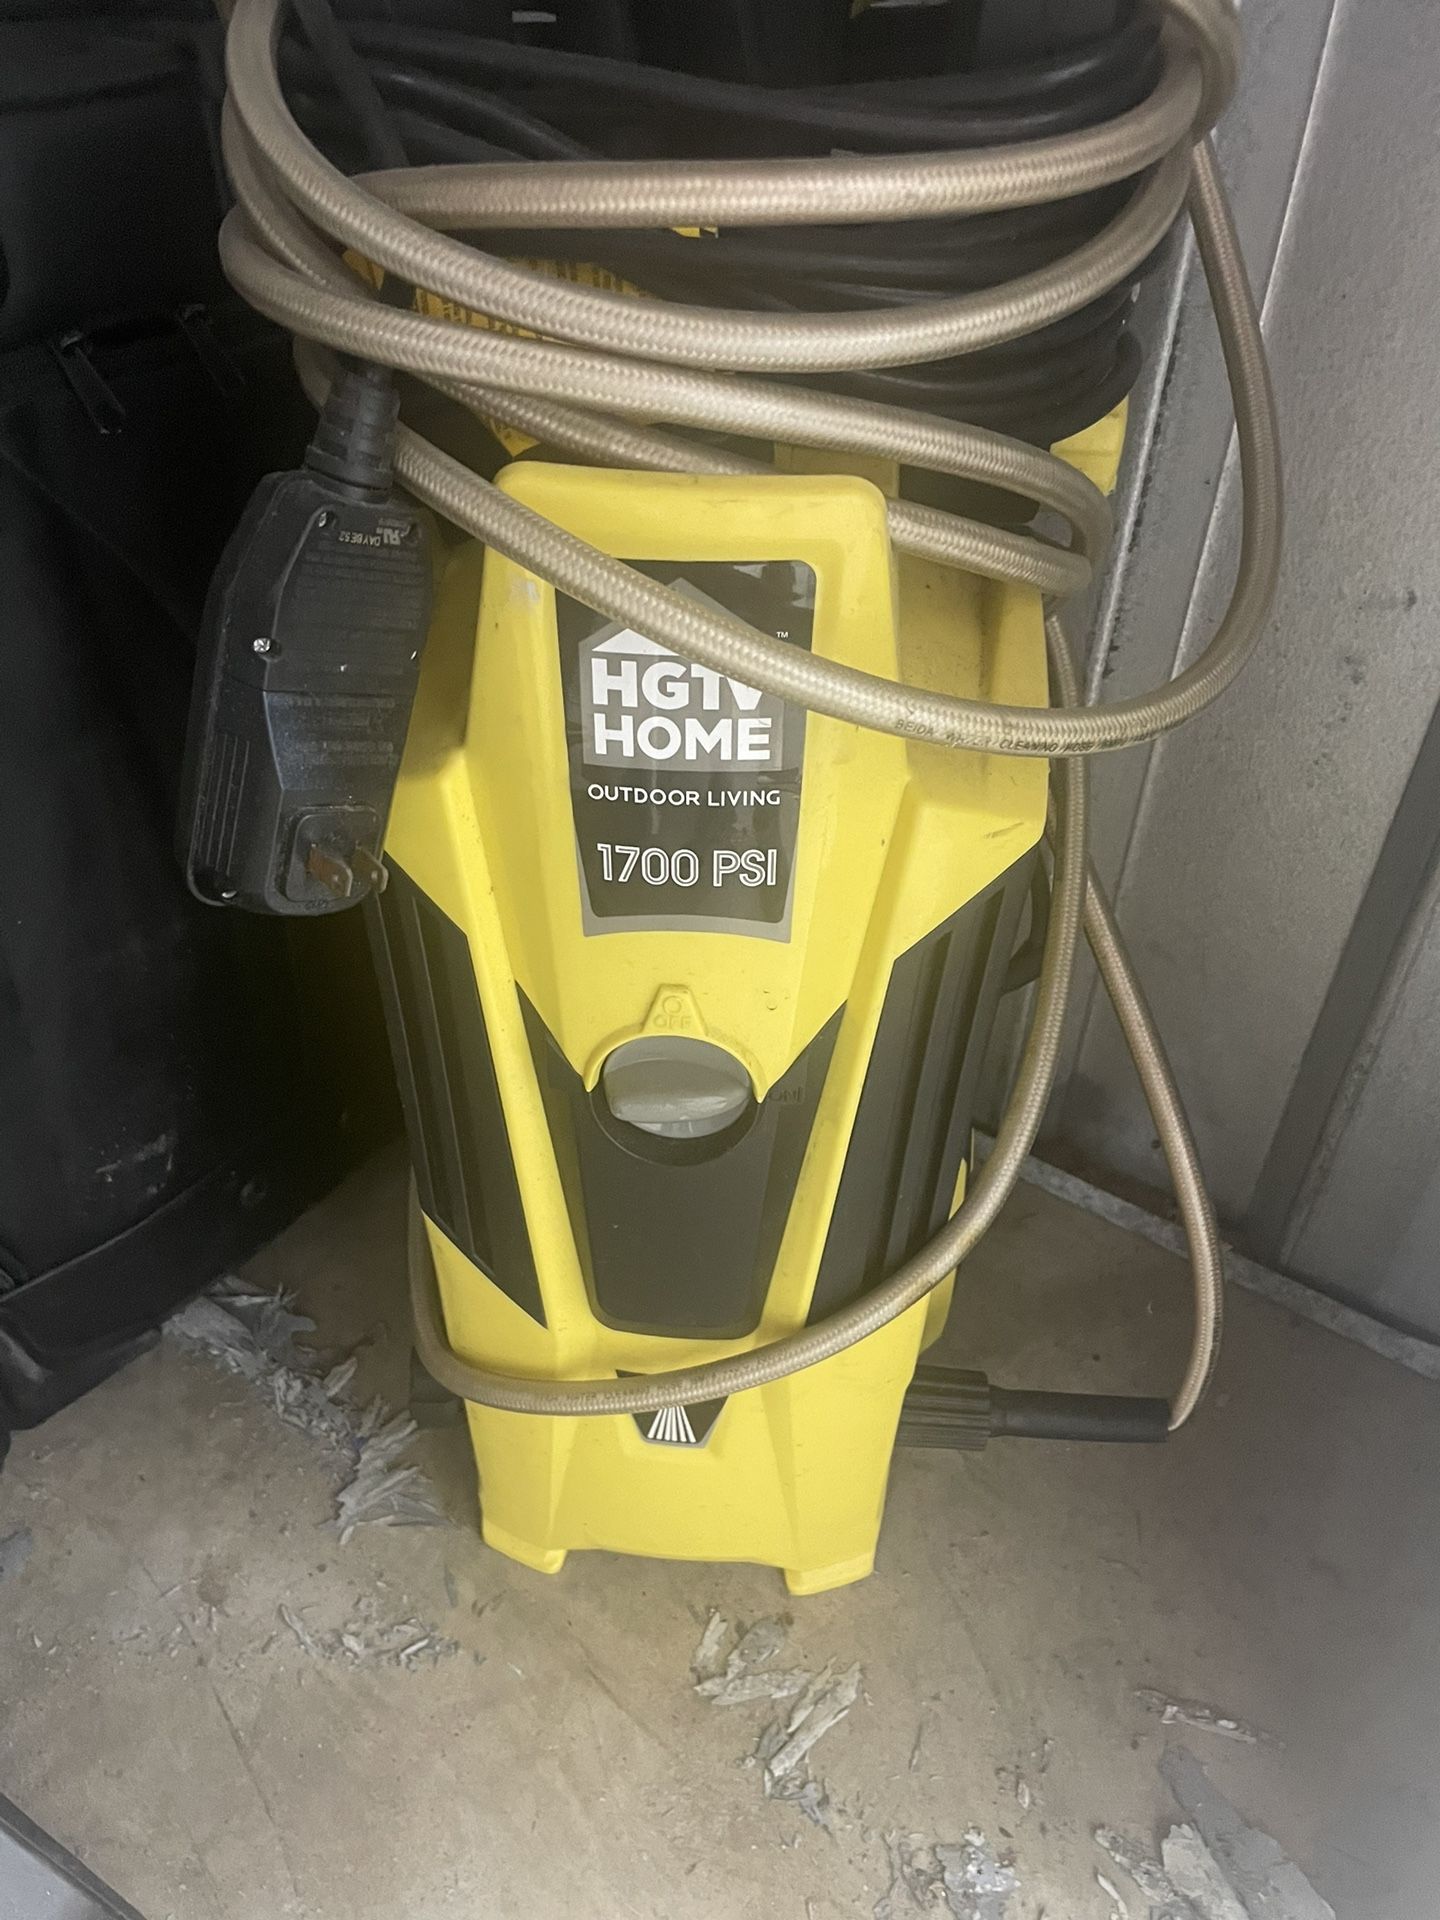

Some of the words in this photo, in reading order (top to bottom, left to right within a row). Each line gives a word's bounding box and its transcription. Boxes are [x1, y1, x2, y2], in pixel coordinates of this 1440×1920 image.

[593, 713, 772, 761] HOME
[587, 783, 700, 807] OUTDOOR
[708, 789, 781, 807] LIVING
[597, 842, 699, 887] 1700
[712, 849, 777, 888] PSI
[653, 1014, 692, 1029] OFF
